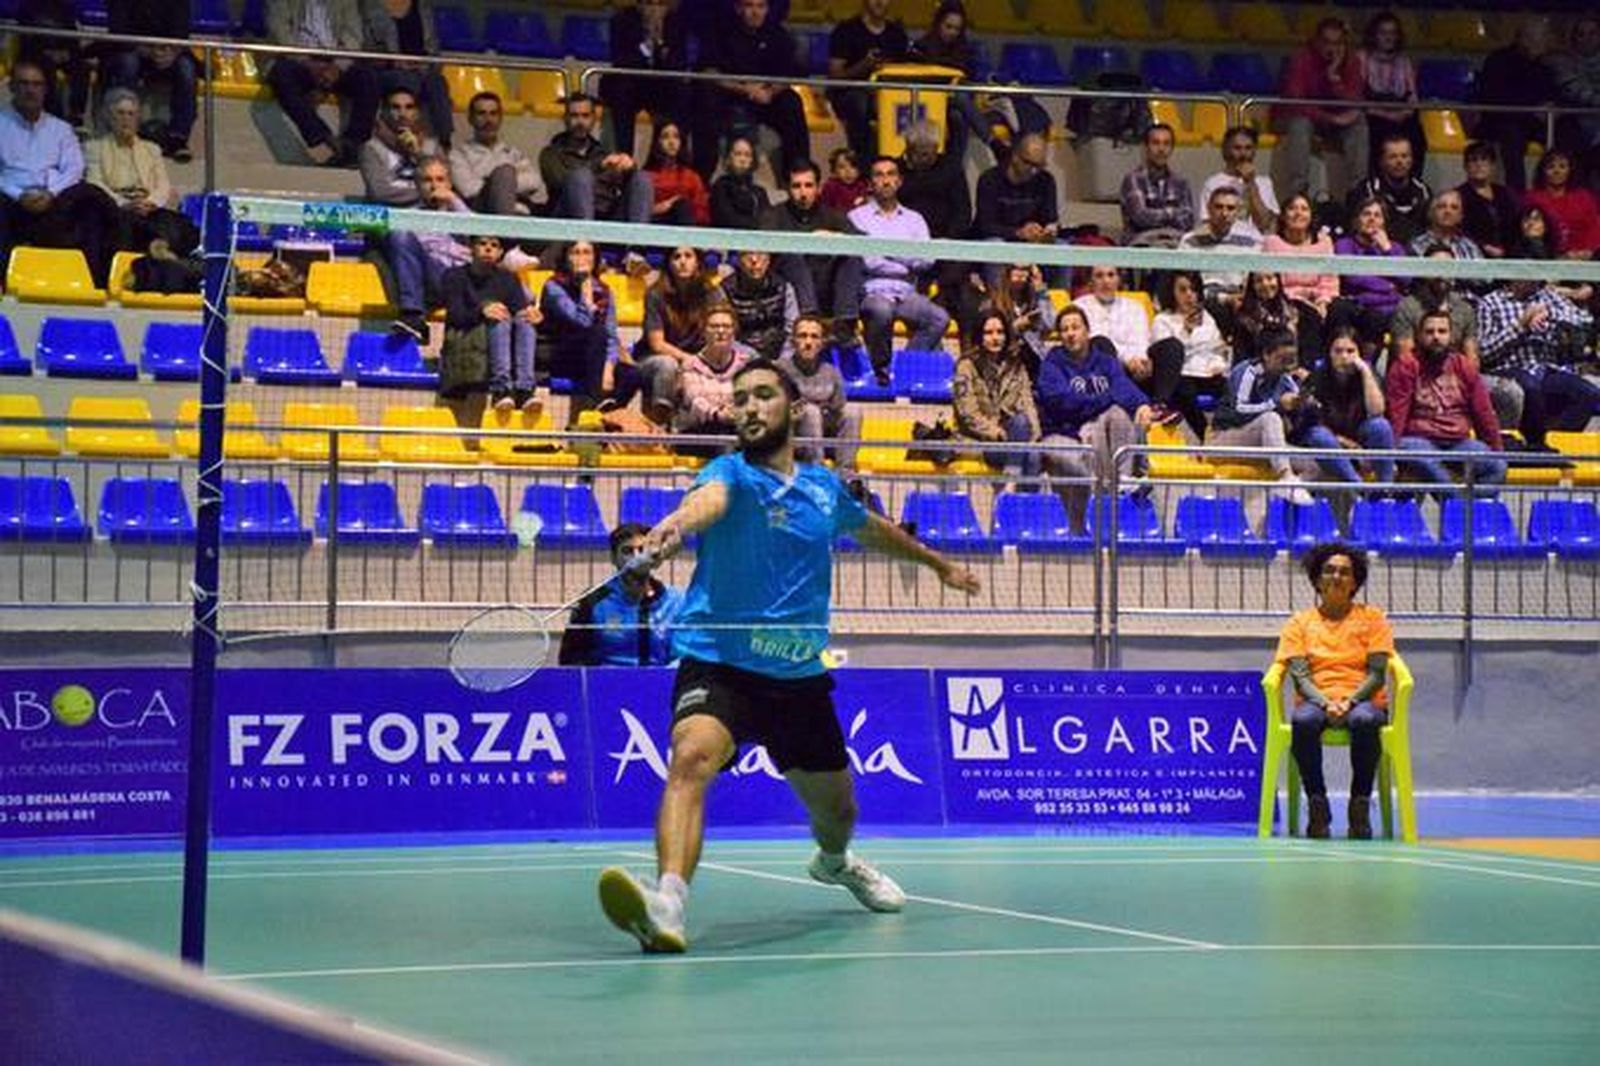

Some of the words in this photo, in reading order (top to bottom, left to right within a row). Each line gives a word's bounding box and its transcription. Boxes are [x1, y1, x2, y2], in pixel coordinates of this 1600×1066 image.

[1155, 682, 1252, 695] DENTAL
[227, 714, 305, 766] FZ
[229, 773, 369, 789] INNOVATED
[387, 773, 411, 787] IN
[429, 771, 535, 786] DENMARK
[26, 790, 125, 806] BENALMÁDENA
[128, 789, 171, 803] COSTA
